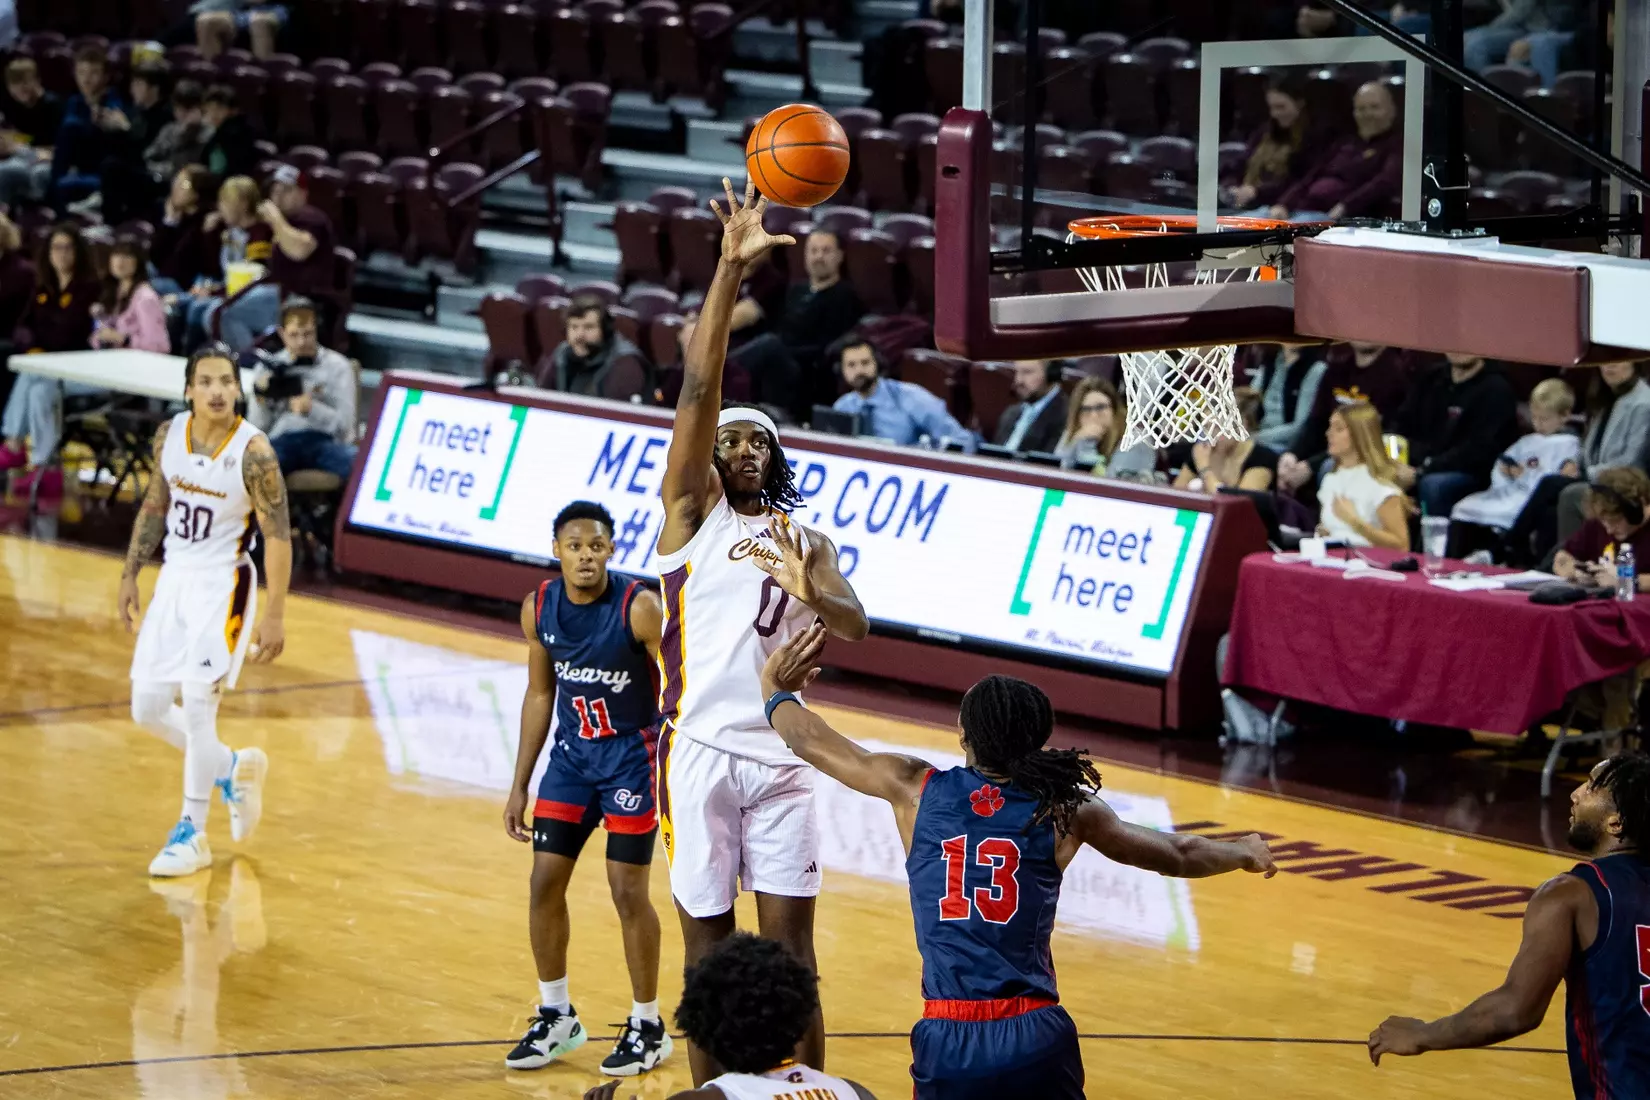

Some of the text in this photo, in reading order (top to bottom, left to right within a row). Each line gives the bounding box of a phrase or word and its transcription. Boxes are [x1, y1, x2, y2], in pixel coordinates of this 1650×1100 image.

[419, 417, 493, 455] meet
[408, 453, 476, 498] here
[588, 430, 949, 543] MEP.COM
[174, 499, 214, 543] 30
[1063, 522, 1153, 565] meet
[753, 575, 790, 638] 0
[1052, 562, 1134, 614] here
[572, 695, 618, 740] 11
[614, 788, 643, 811] CU
[939, 833, 1032, 926] 13
